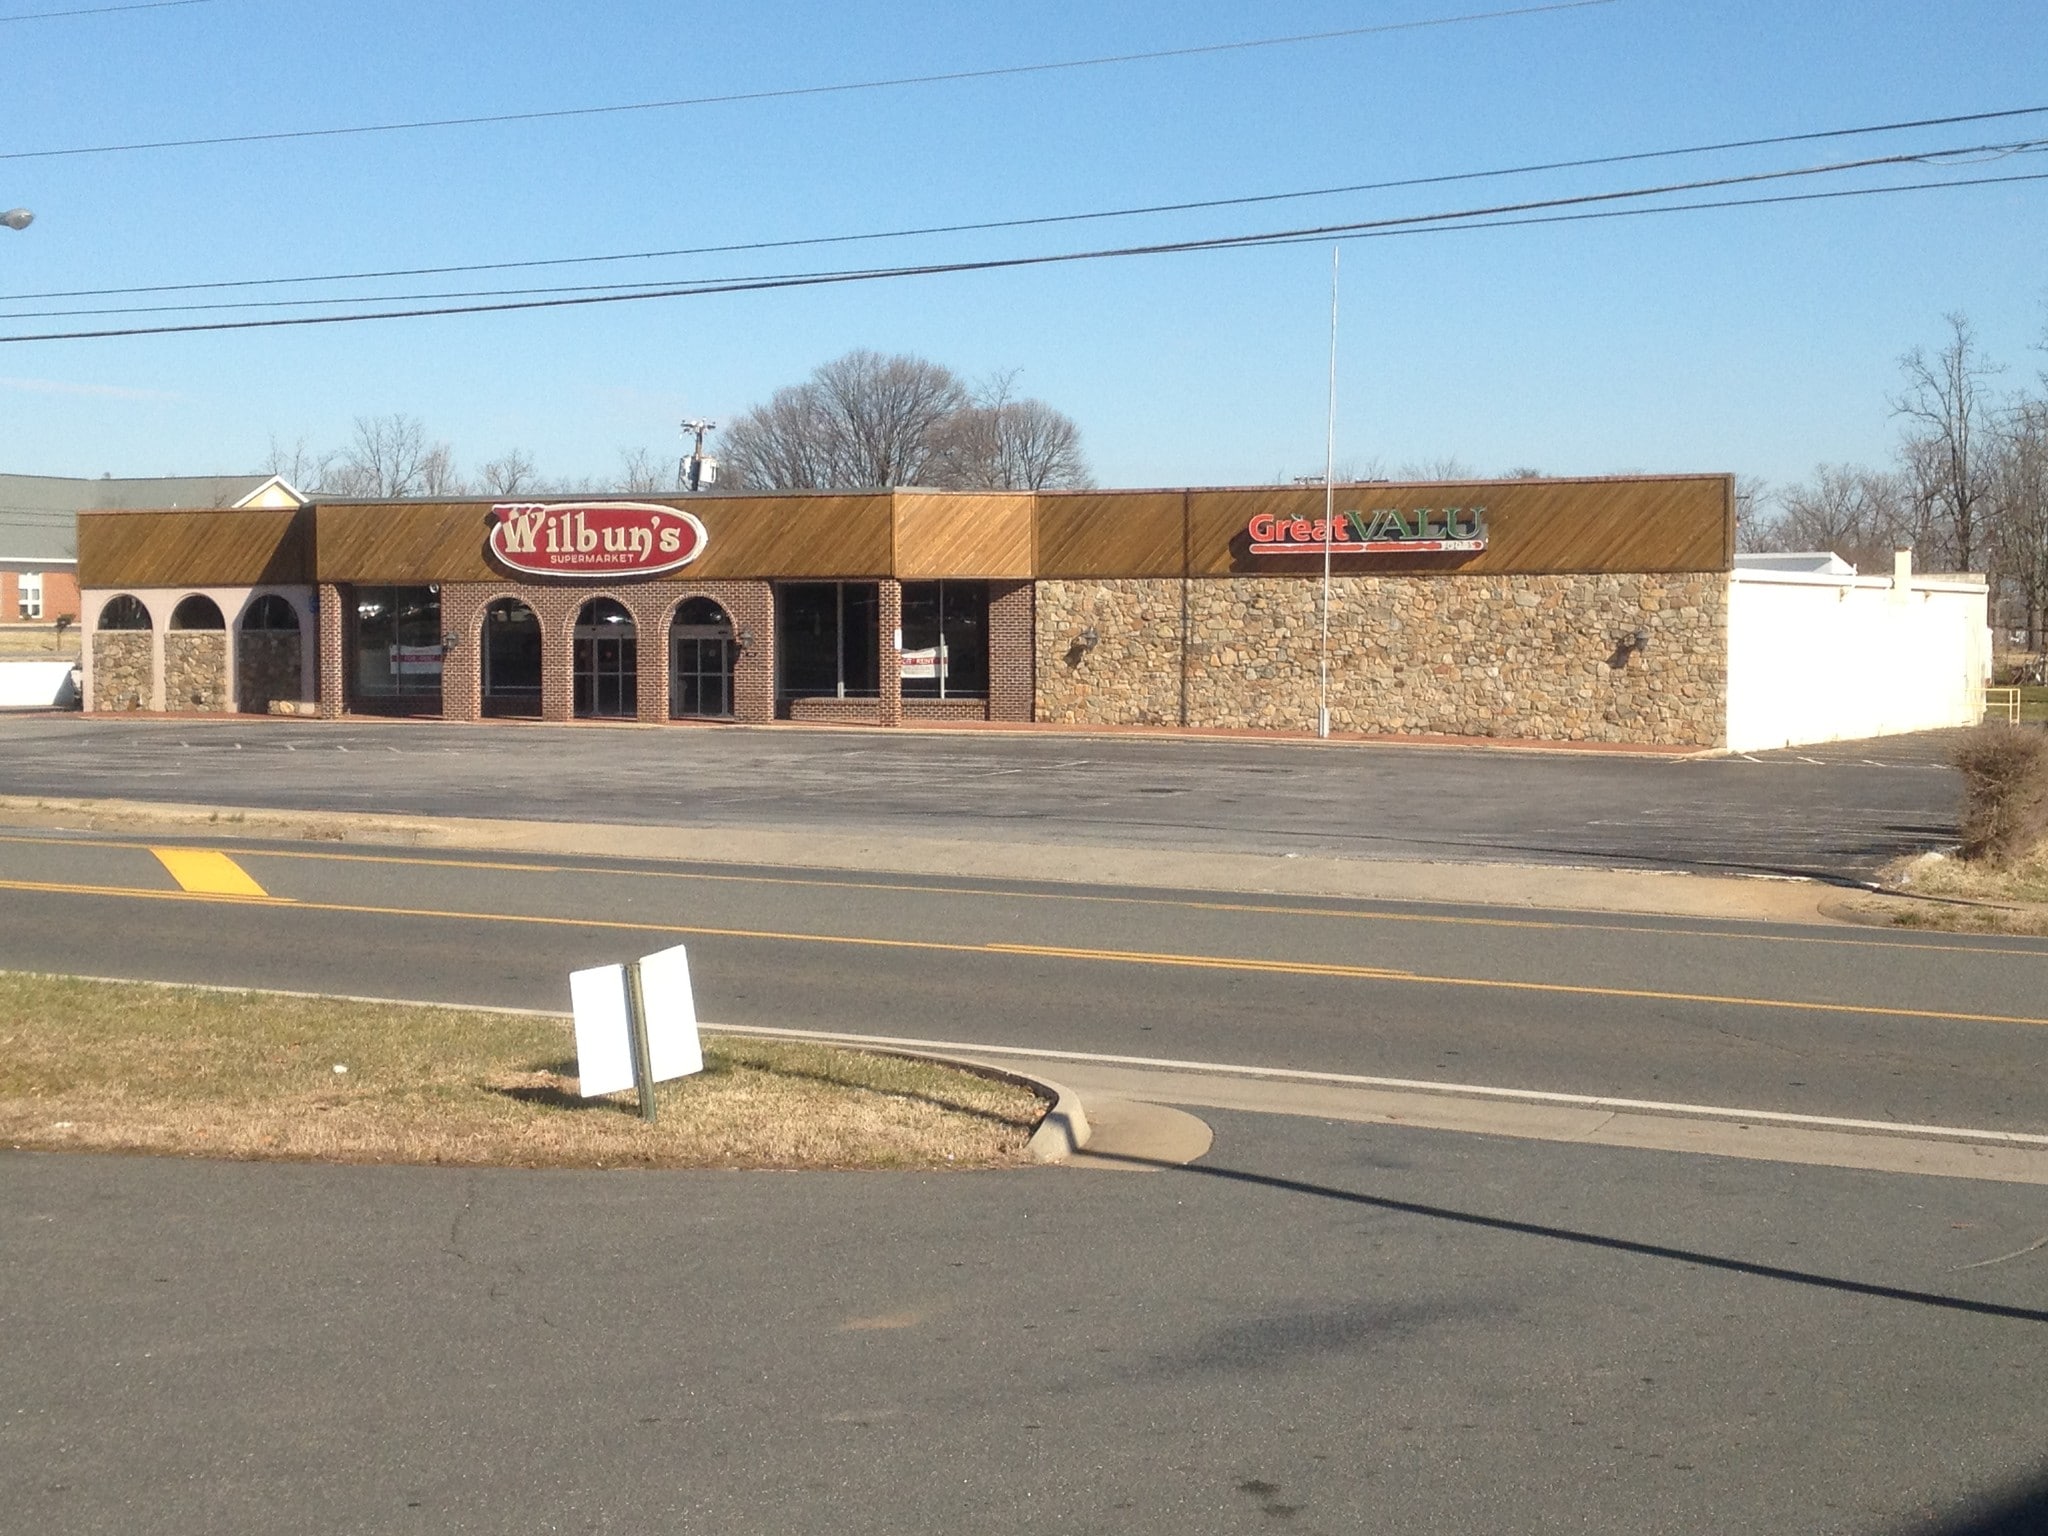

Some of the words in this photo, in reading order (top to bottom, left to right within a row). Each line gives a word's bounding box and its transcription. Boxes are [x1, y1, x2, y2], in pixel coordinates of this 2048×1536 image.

[1248, 513, 1349, 542] Great
[1345, 507, 1487, 541] VALU
[550, 553, 634, 564] SUPERMARKET
